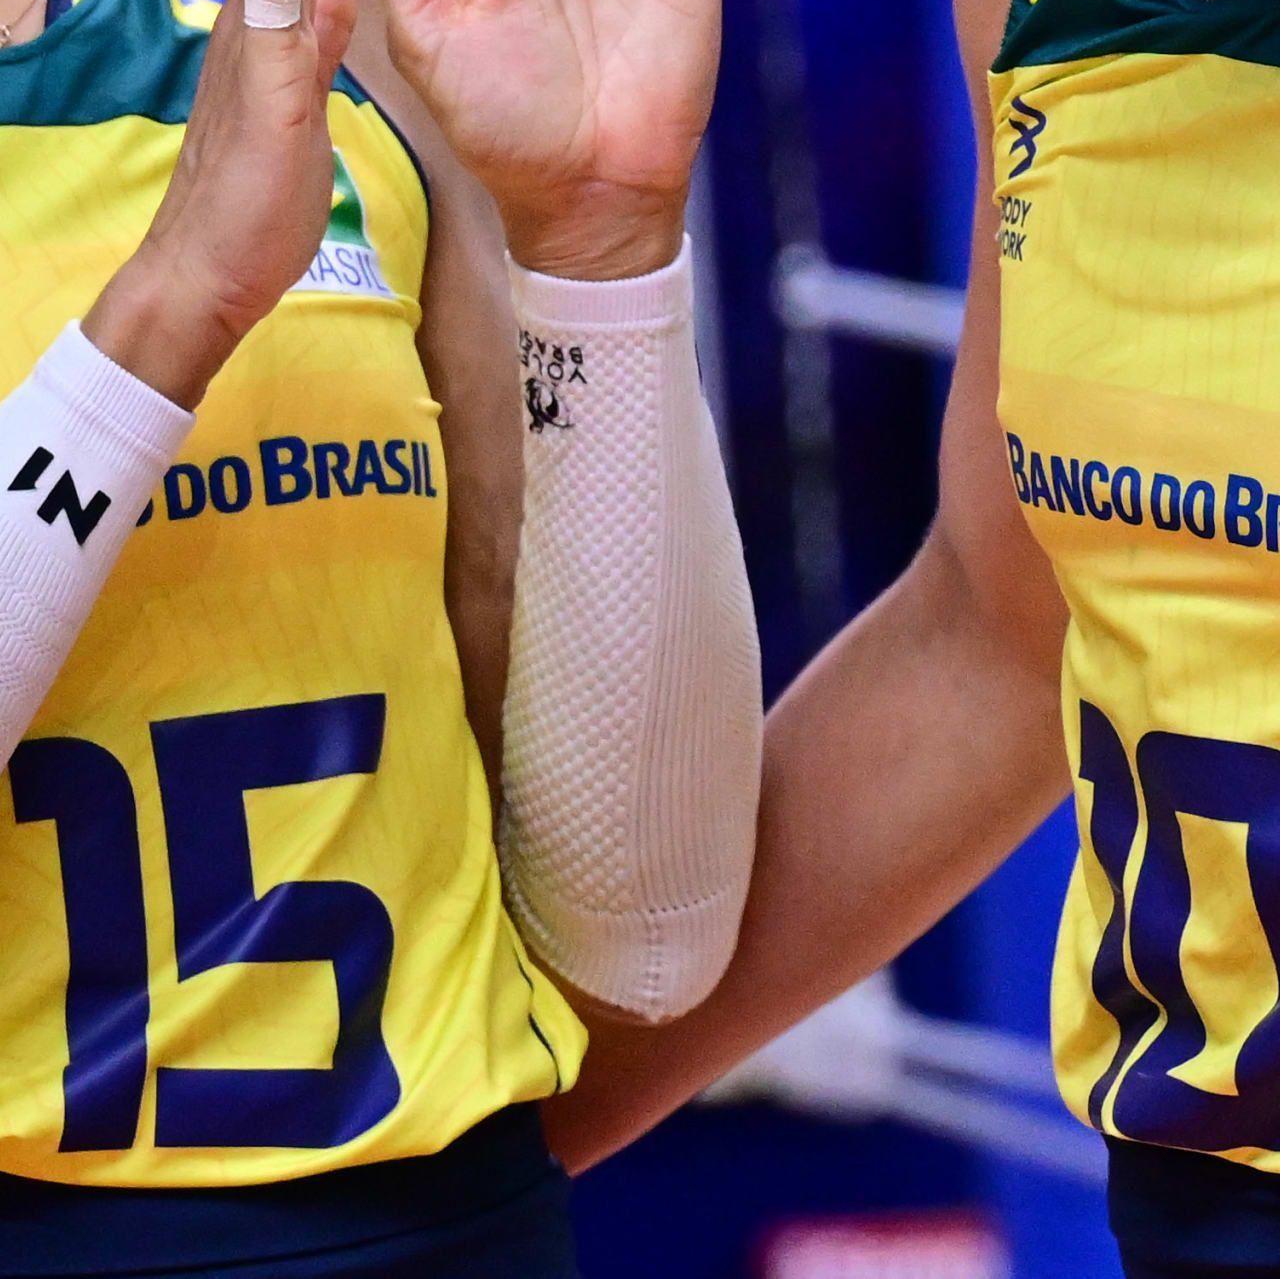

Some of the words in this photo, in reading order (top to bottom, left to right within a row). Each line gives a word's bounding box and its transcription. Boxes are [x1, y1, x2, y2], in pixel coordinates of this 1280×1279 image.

[308, 247, 390, 292] ASIL
[999, 229, 1027, 262] ORK
[163, 455, 251, 522] DO
[258, 435, 438, 507] BRASIL
[1006, 431, 1143, 526] BANCO
[1150, 472, 1217, 540] DO
[7, 692, 402, 1153] 15
